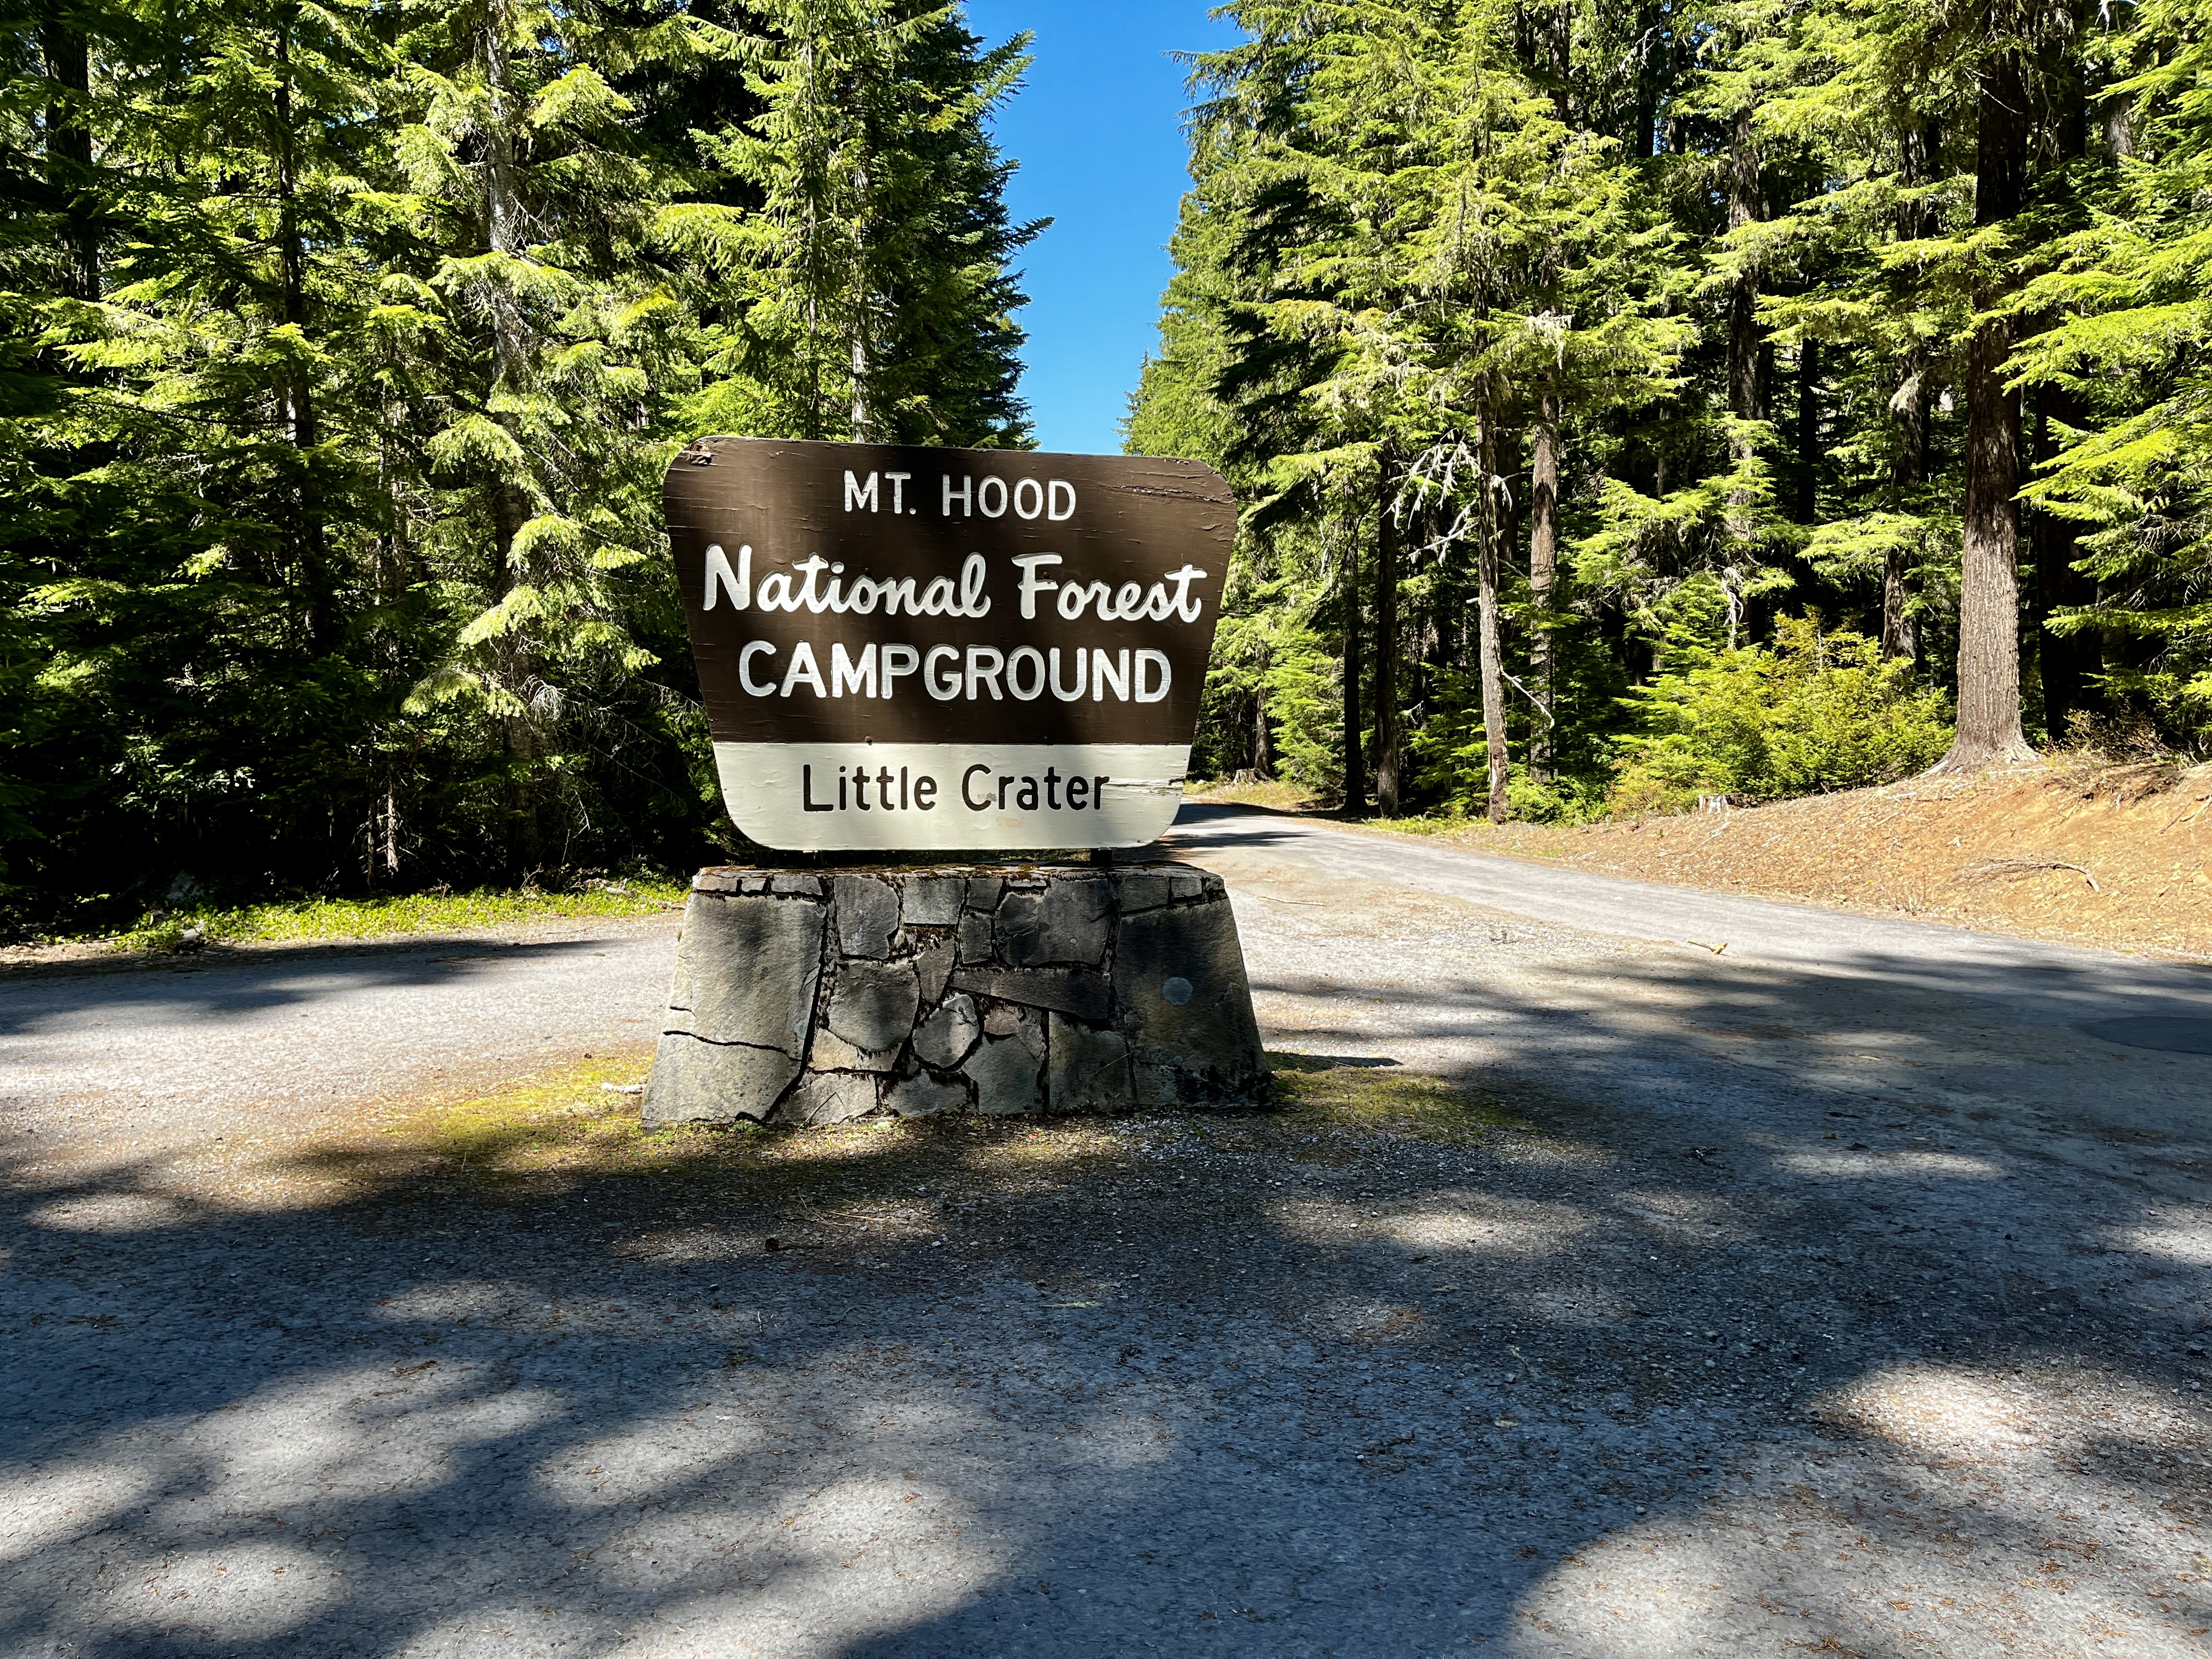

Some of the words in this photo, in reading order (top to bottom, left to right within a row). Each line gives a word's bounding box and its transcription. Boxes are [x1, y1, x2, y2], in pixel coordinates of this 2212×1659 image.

[844, 470, 916, 514] MT.
[943, 476, 1076, 521] HOOD
[703, 543, 991, 618] National
[1012, 553, 1207, 623] Forest
[740, 641, 1171, 703] CAMPGROUND
[804, 765, 937, 812] Little
[962, 764, 1110, 811] Crater
